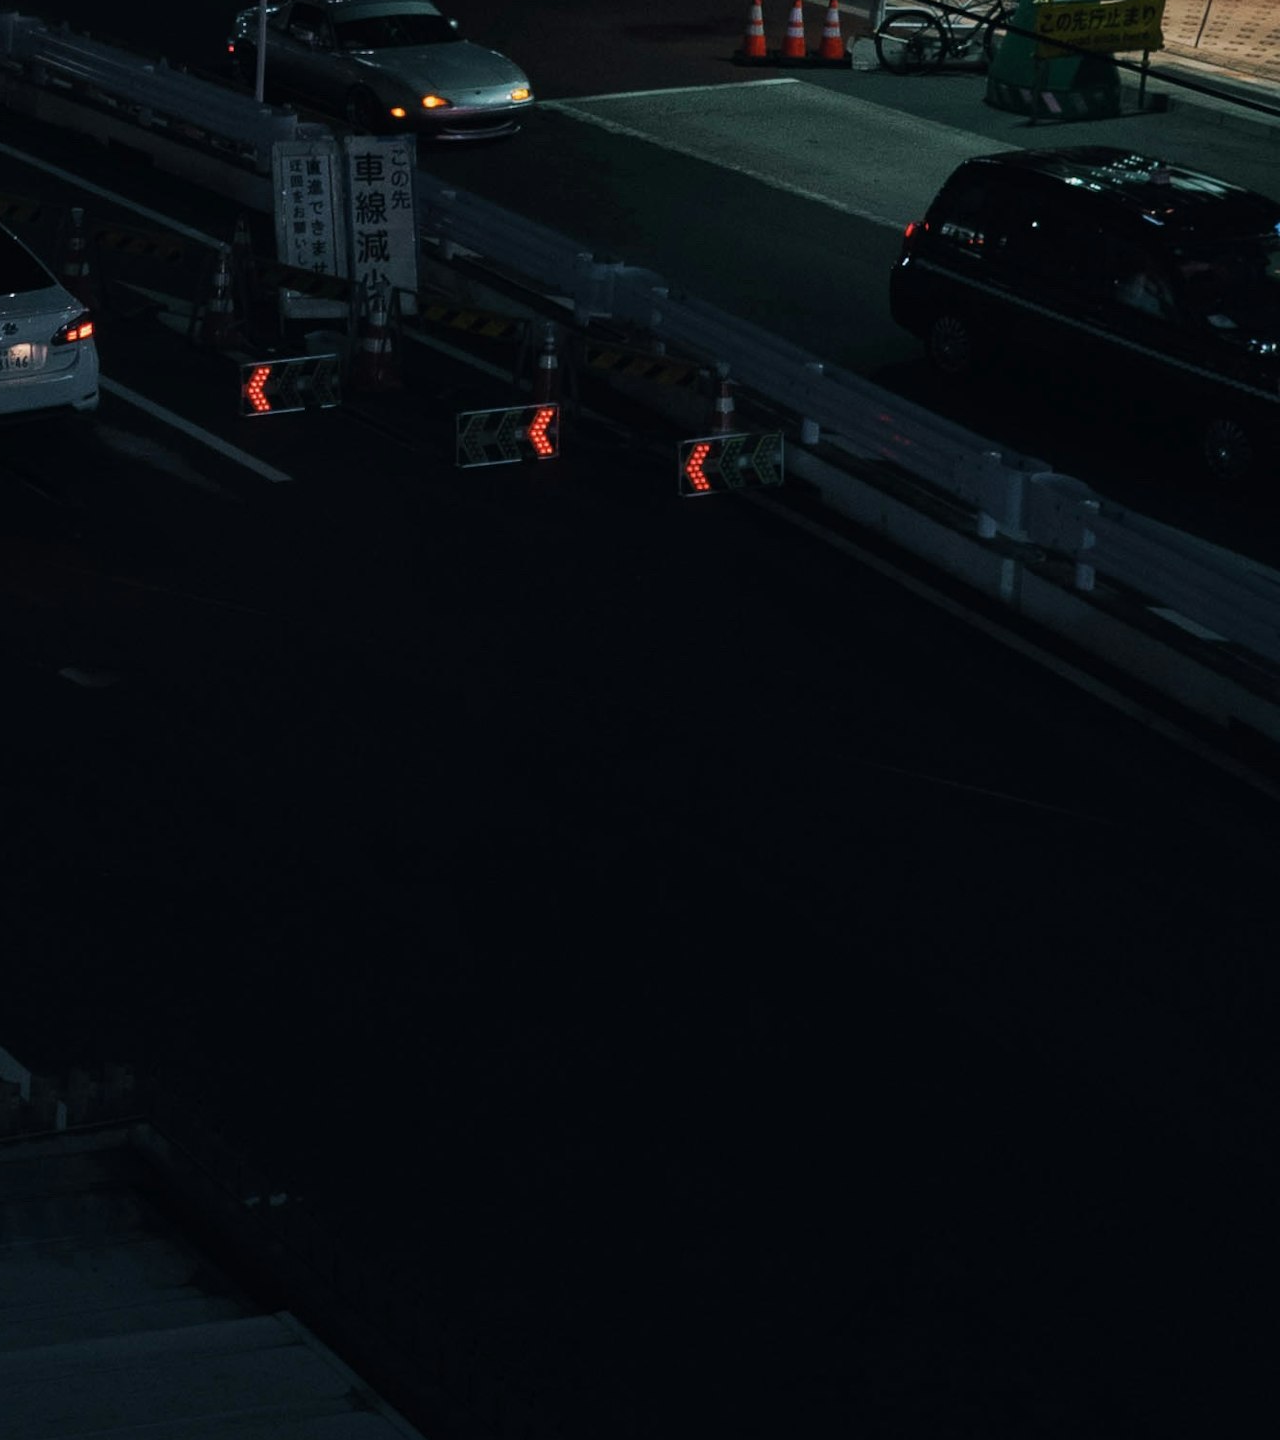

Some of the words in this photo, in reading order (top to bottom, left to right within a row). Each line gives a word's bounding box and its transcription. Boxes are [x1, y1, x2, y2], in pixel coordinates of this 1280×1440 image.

[1041, 4, 1156, 33] この先行止まり
[391, 149, 411, 210] この先
